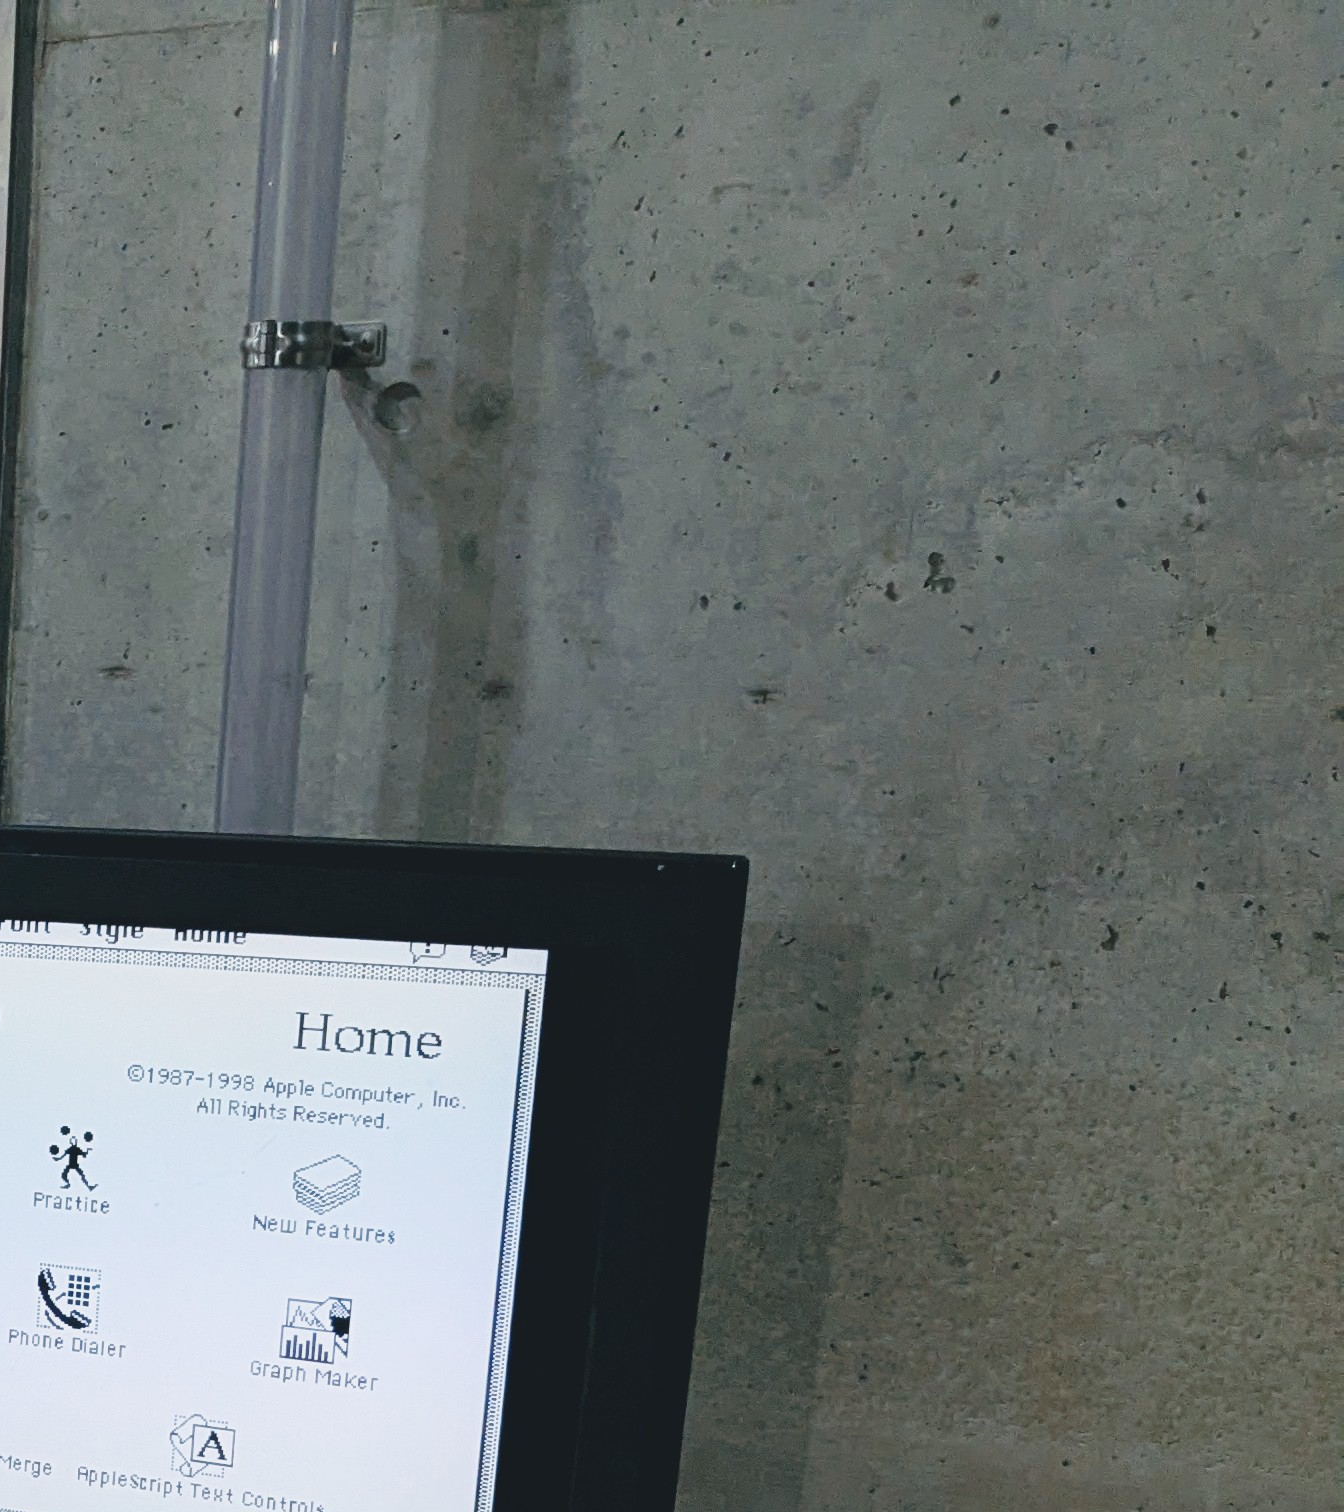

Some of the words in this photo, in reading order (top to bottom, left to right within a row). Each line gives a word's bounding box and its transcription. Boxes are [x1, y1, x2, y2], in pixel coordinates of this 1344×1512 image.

[293, 1011, 442, 1060] Home
[263, 1076, 315, 1099] Apple
[320, 1081, 423, 1110] Computer,
[432, 1090, 466, 1110] Inc.
[196, 1097, 222, 1115] All
[228, 1099, 287, 1122] Rights
[292, 1105, 390, 1130] Reserved.
[33, 1191, 110, 1215] Practice
[252, 1214, 297, 1234] New
[305, 1219, 396, 1245] Features
[8, 1328, 64, 1350] Phone
[71, 1336, 127, 1358] Dialer
[250, 1360, 307, 1384] Graph
[314, 1368, 379, 1391] Maker
[77, 1465, 183, 1499] AppleScript
[190, 1482, 233, 1504] Text
